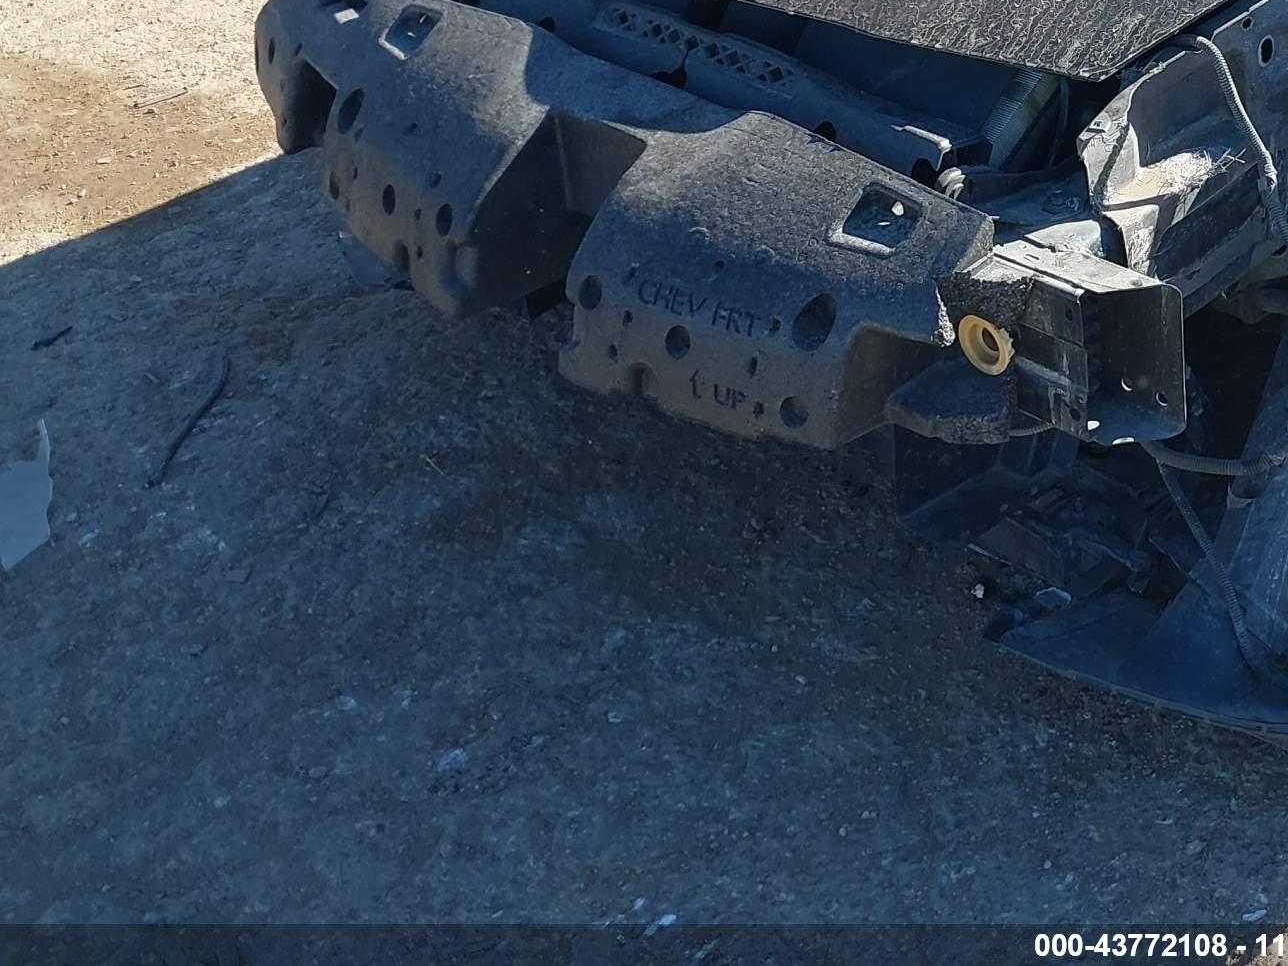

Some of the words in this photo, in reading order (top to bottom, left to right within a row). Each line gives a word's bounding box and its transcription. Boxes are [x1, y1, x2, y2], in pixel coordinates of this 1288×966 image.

[638, 280, 708, 316] CHEV
[711, 301, 762, 338] FRT
[713, 383, 746, 410] UP
